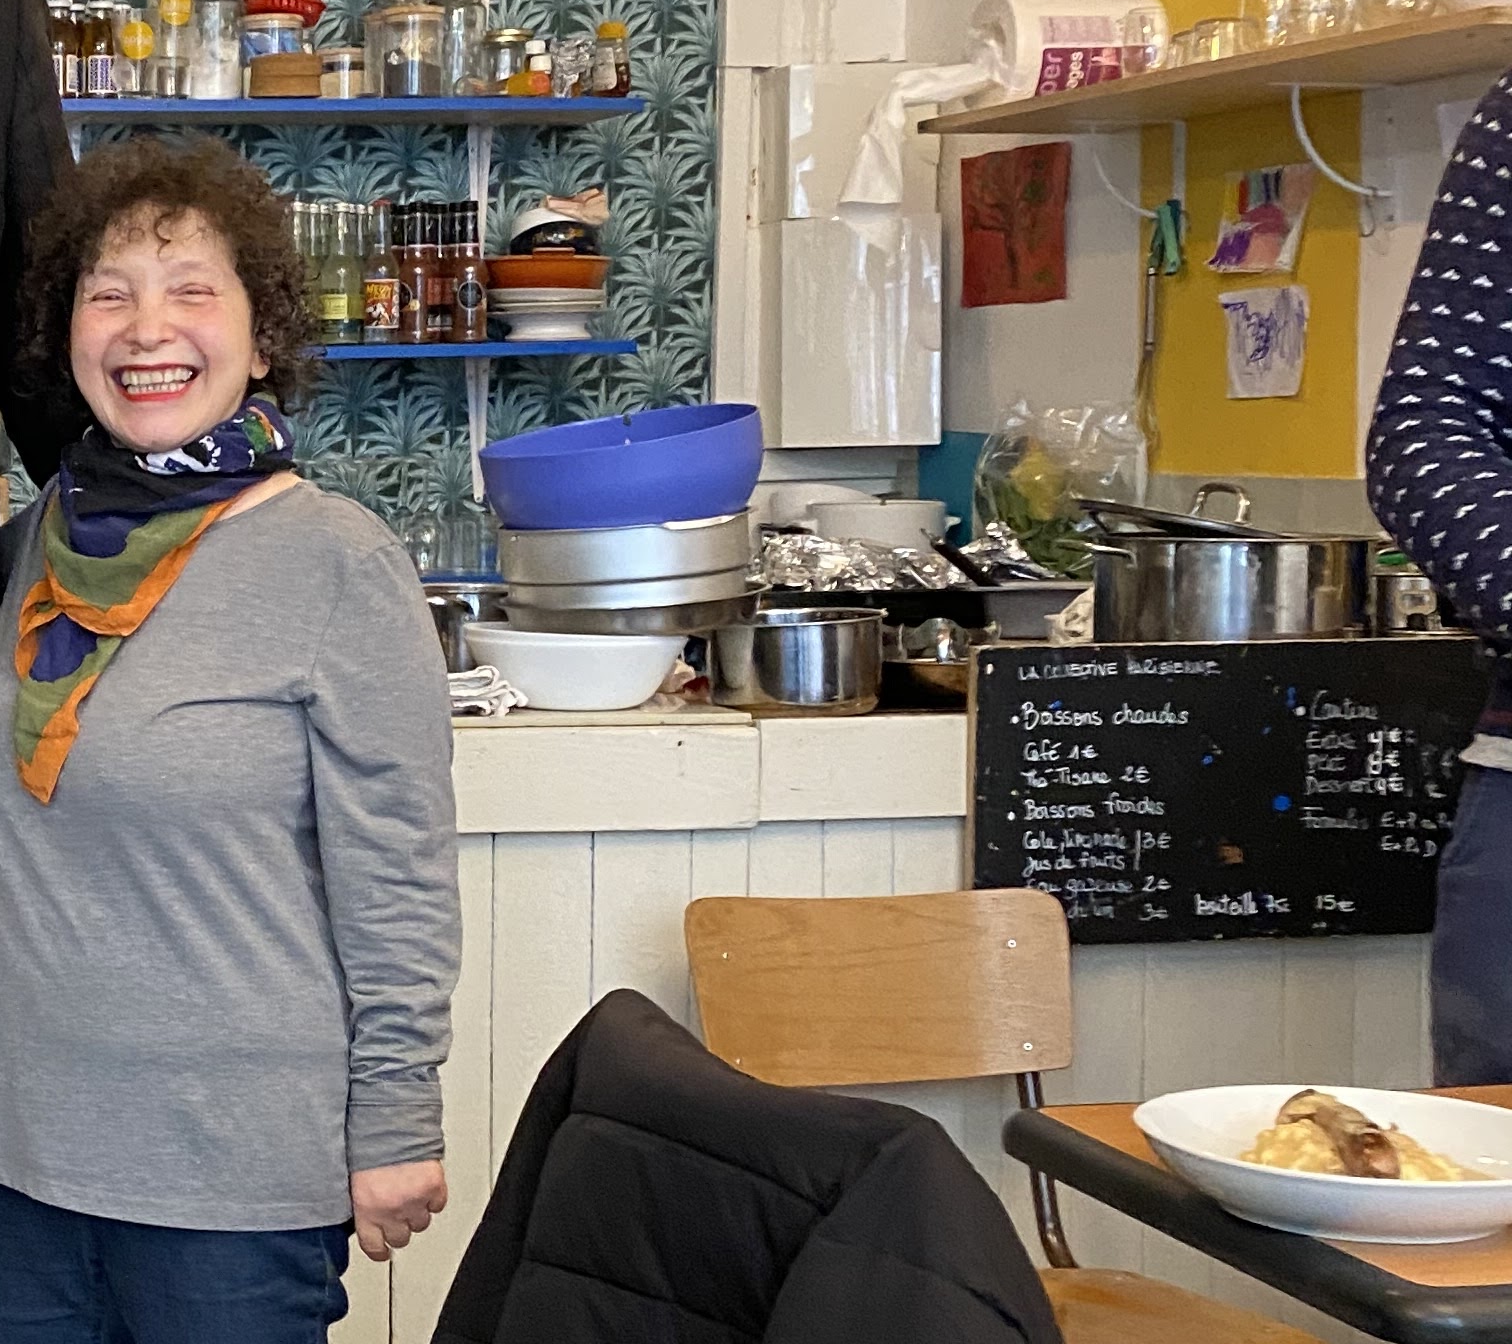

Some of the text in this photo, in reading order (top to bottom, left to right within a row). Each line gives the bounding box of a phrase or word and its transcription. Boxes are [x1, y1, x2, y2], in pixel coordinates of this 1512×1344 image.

[1020, 701, 1190, 731] Boissons chaudes
[1023, 739, 1063, 762] Café
[1023, 791, 1166, 821] Boissons froides
